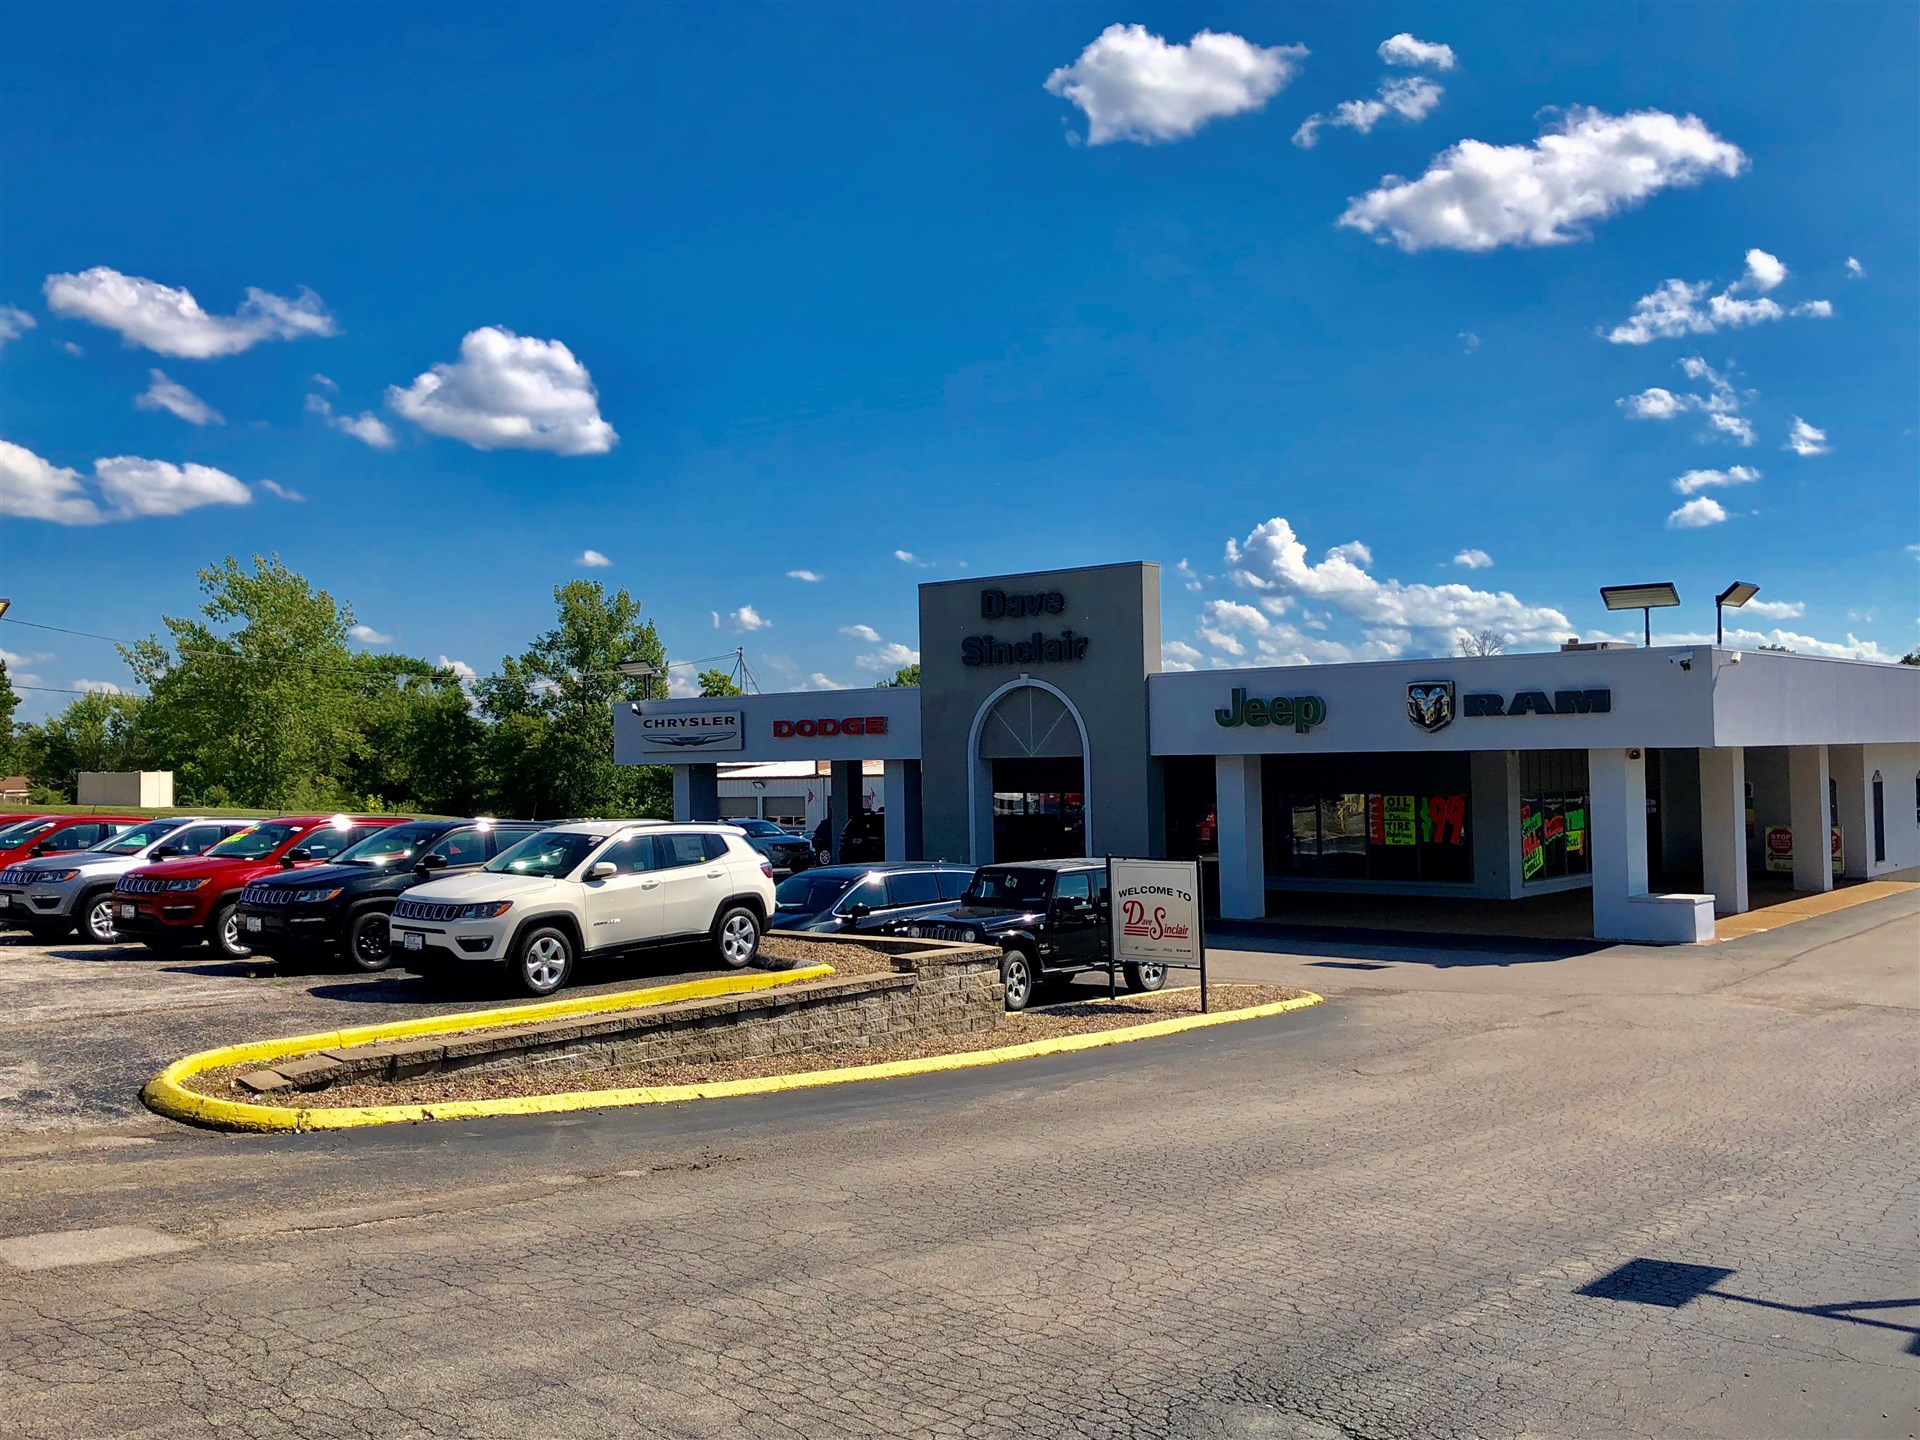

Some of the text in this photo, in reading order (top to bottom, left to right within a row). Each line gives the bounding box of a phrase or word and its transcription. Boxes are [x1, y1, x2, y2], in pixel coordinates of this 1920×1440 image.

[981, 588, 1065, 619] Dave
[961, 630, 1089, 666] Sinclair
[1214, 687, 1327, 734] Jeep
[1463, 688, 1611, 717] RAM
[643, 716, 736, 729] CHRYSLER
[773, 716, 888, 738] DODGE
[1386, 797, 1411, 807] OIL
[1385, 822, 1411, 831] TIRE
[1118, 885, 1192, 902] WELCOME TO
[1122, 900, 1189, 940] Dave Sinclair
